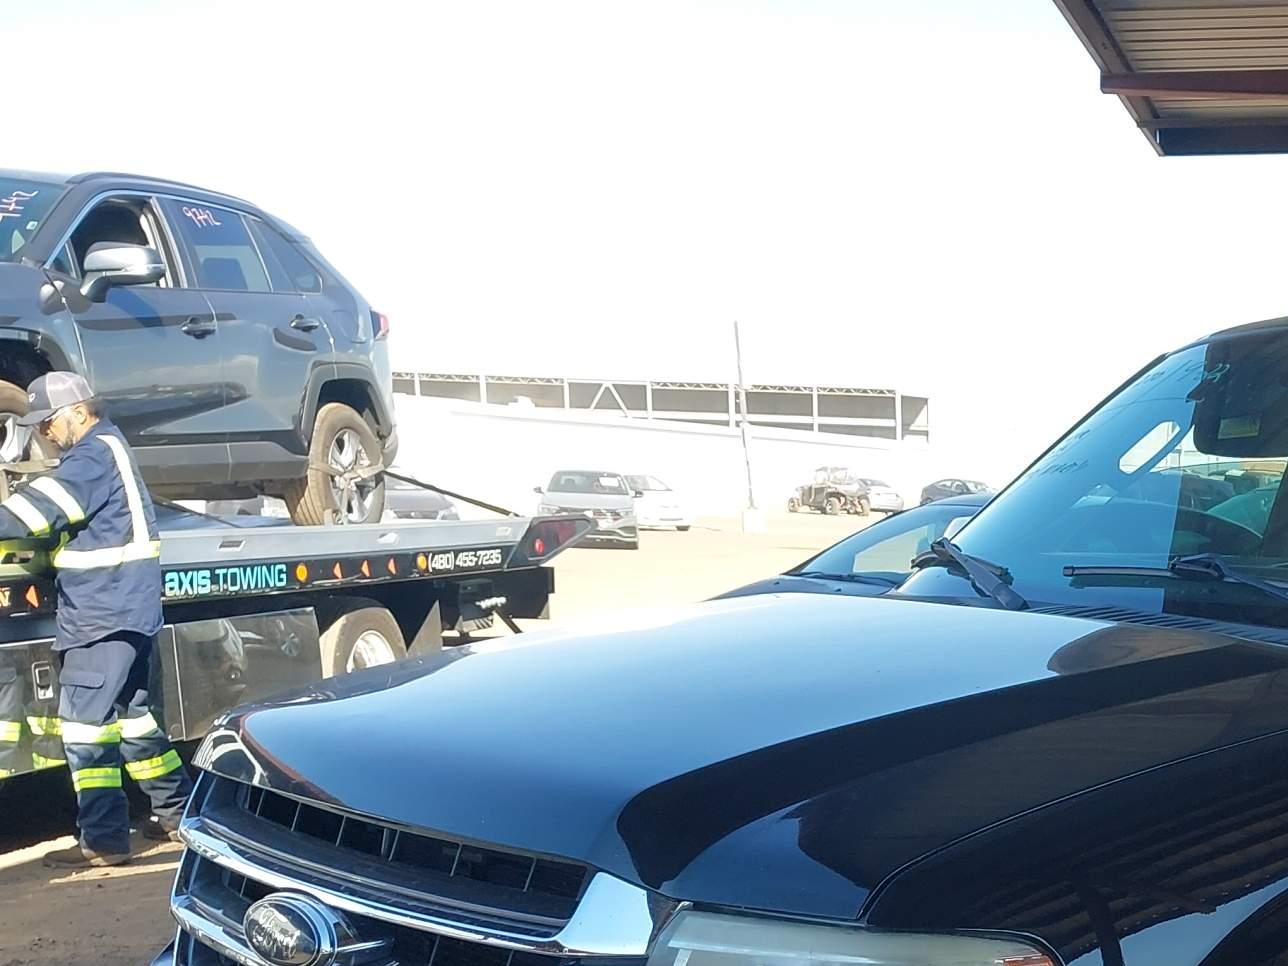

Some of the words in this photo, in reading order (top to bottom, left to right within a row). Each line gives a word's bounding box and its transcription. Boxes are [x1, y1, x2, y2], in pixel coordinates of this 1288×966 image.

[428, 551, 454, 572] (480)
[455, 549, 502, 567] 455-7235
[215, 563, 287, 592] TOWING
